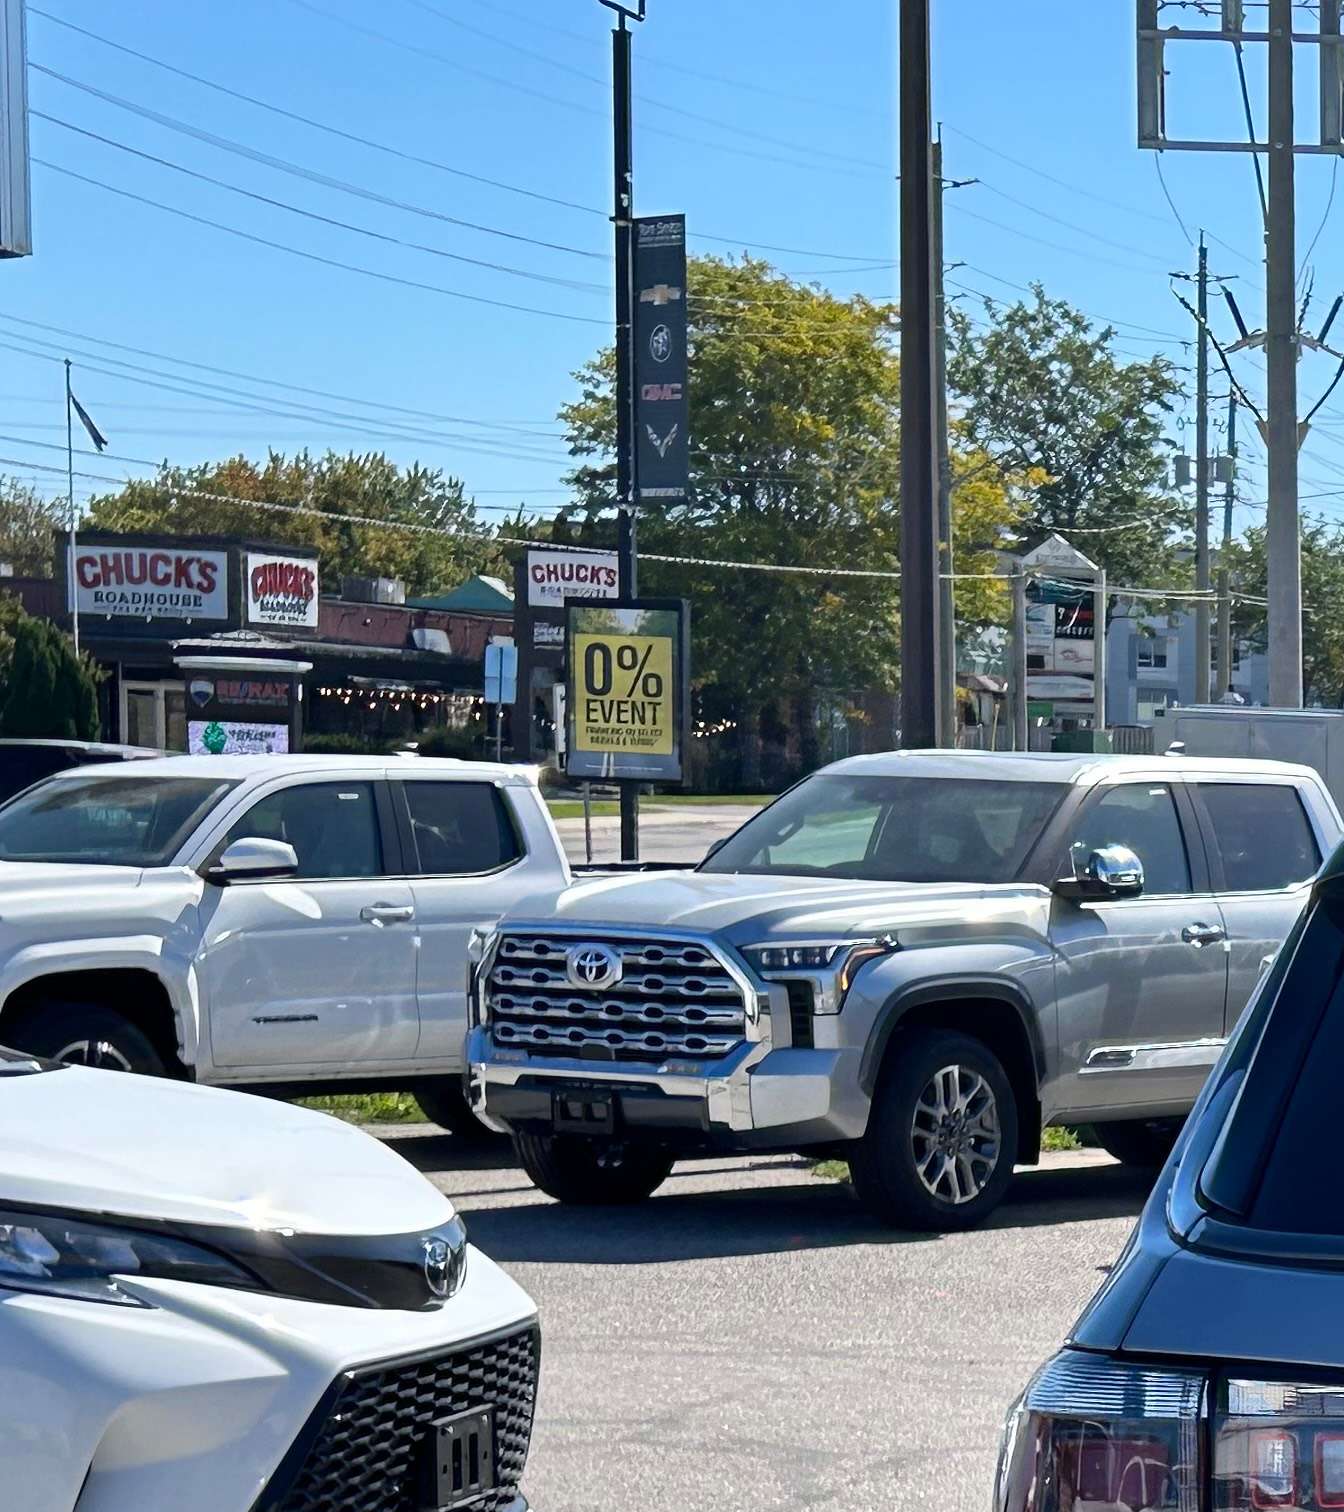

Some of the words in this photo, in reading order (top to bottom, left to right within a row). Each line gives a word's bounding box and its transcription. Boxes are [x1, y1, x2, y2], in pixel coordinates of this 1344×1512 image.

[76, 551, 219, 595] CHUCK'S
[531, 563, 617, 588] CHUCK'S
[94, 590, 203, 608] ROADHOUSE
[584, 642, 664, 699] 0%
[586, 699, 662, 726] EVENT
